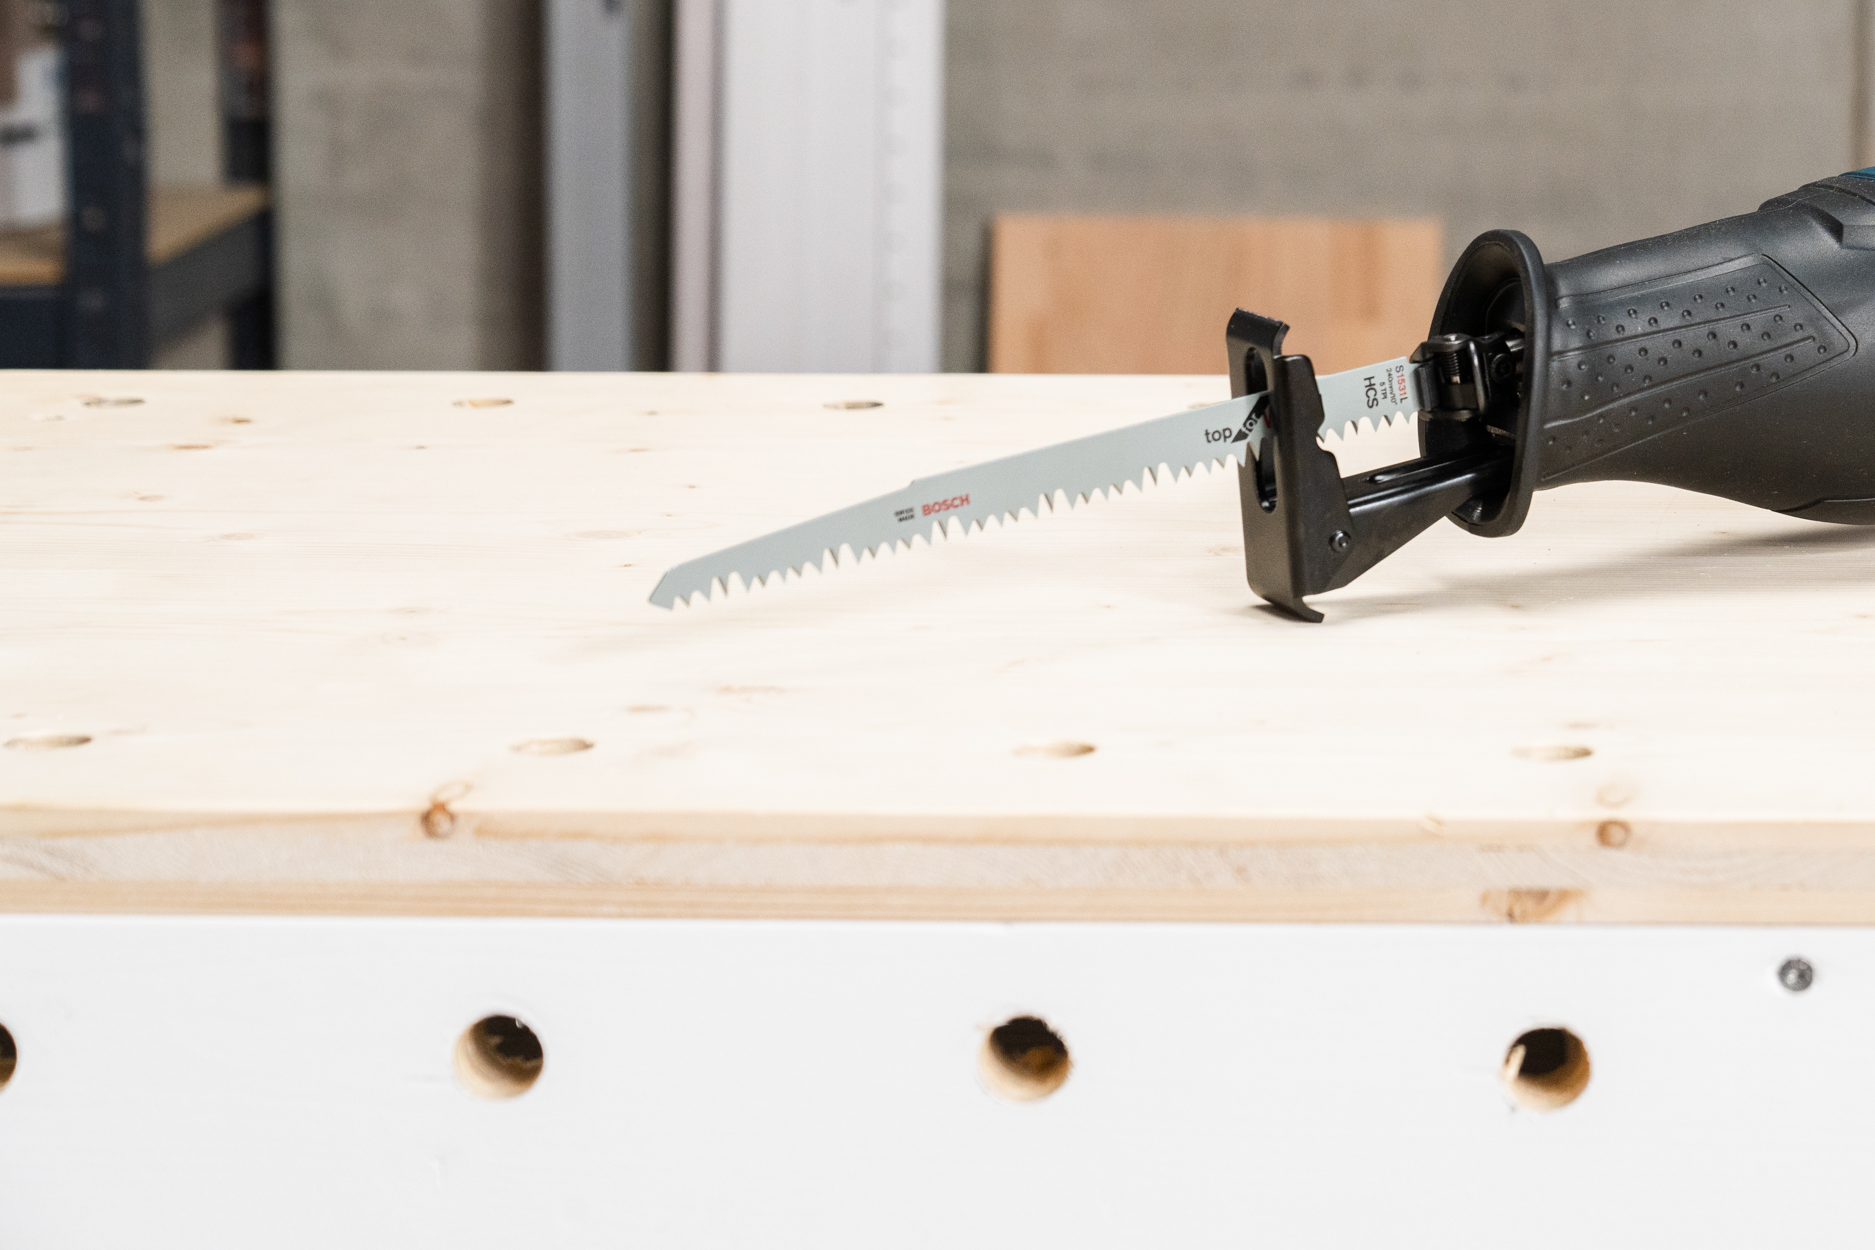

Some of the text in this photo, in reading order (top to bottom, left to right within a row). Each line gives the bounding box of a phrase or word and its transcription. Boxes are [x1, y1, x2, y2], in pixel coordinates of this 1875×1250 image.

[1363, 375, 1379, 409] HCS
[1395, 365, 1408, 403] S1531L
[1204, 427, 1233, 444] top
[921, 493, 970, 517] BOSCH
